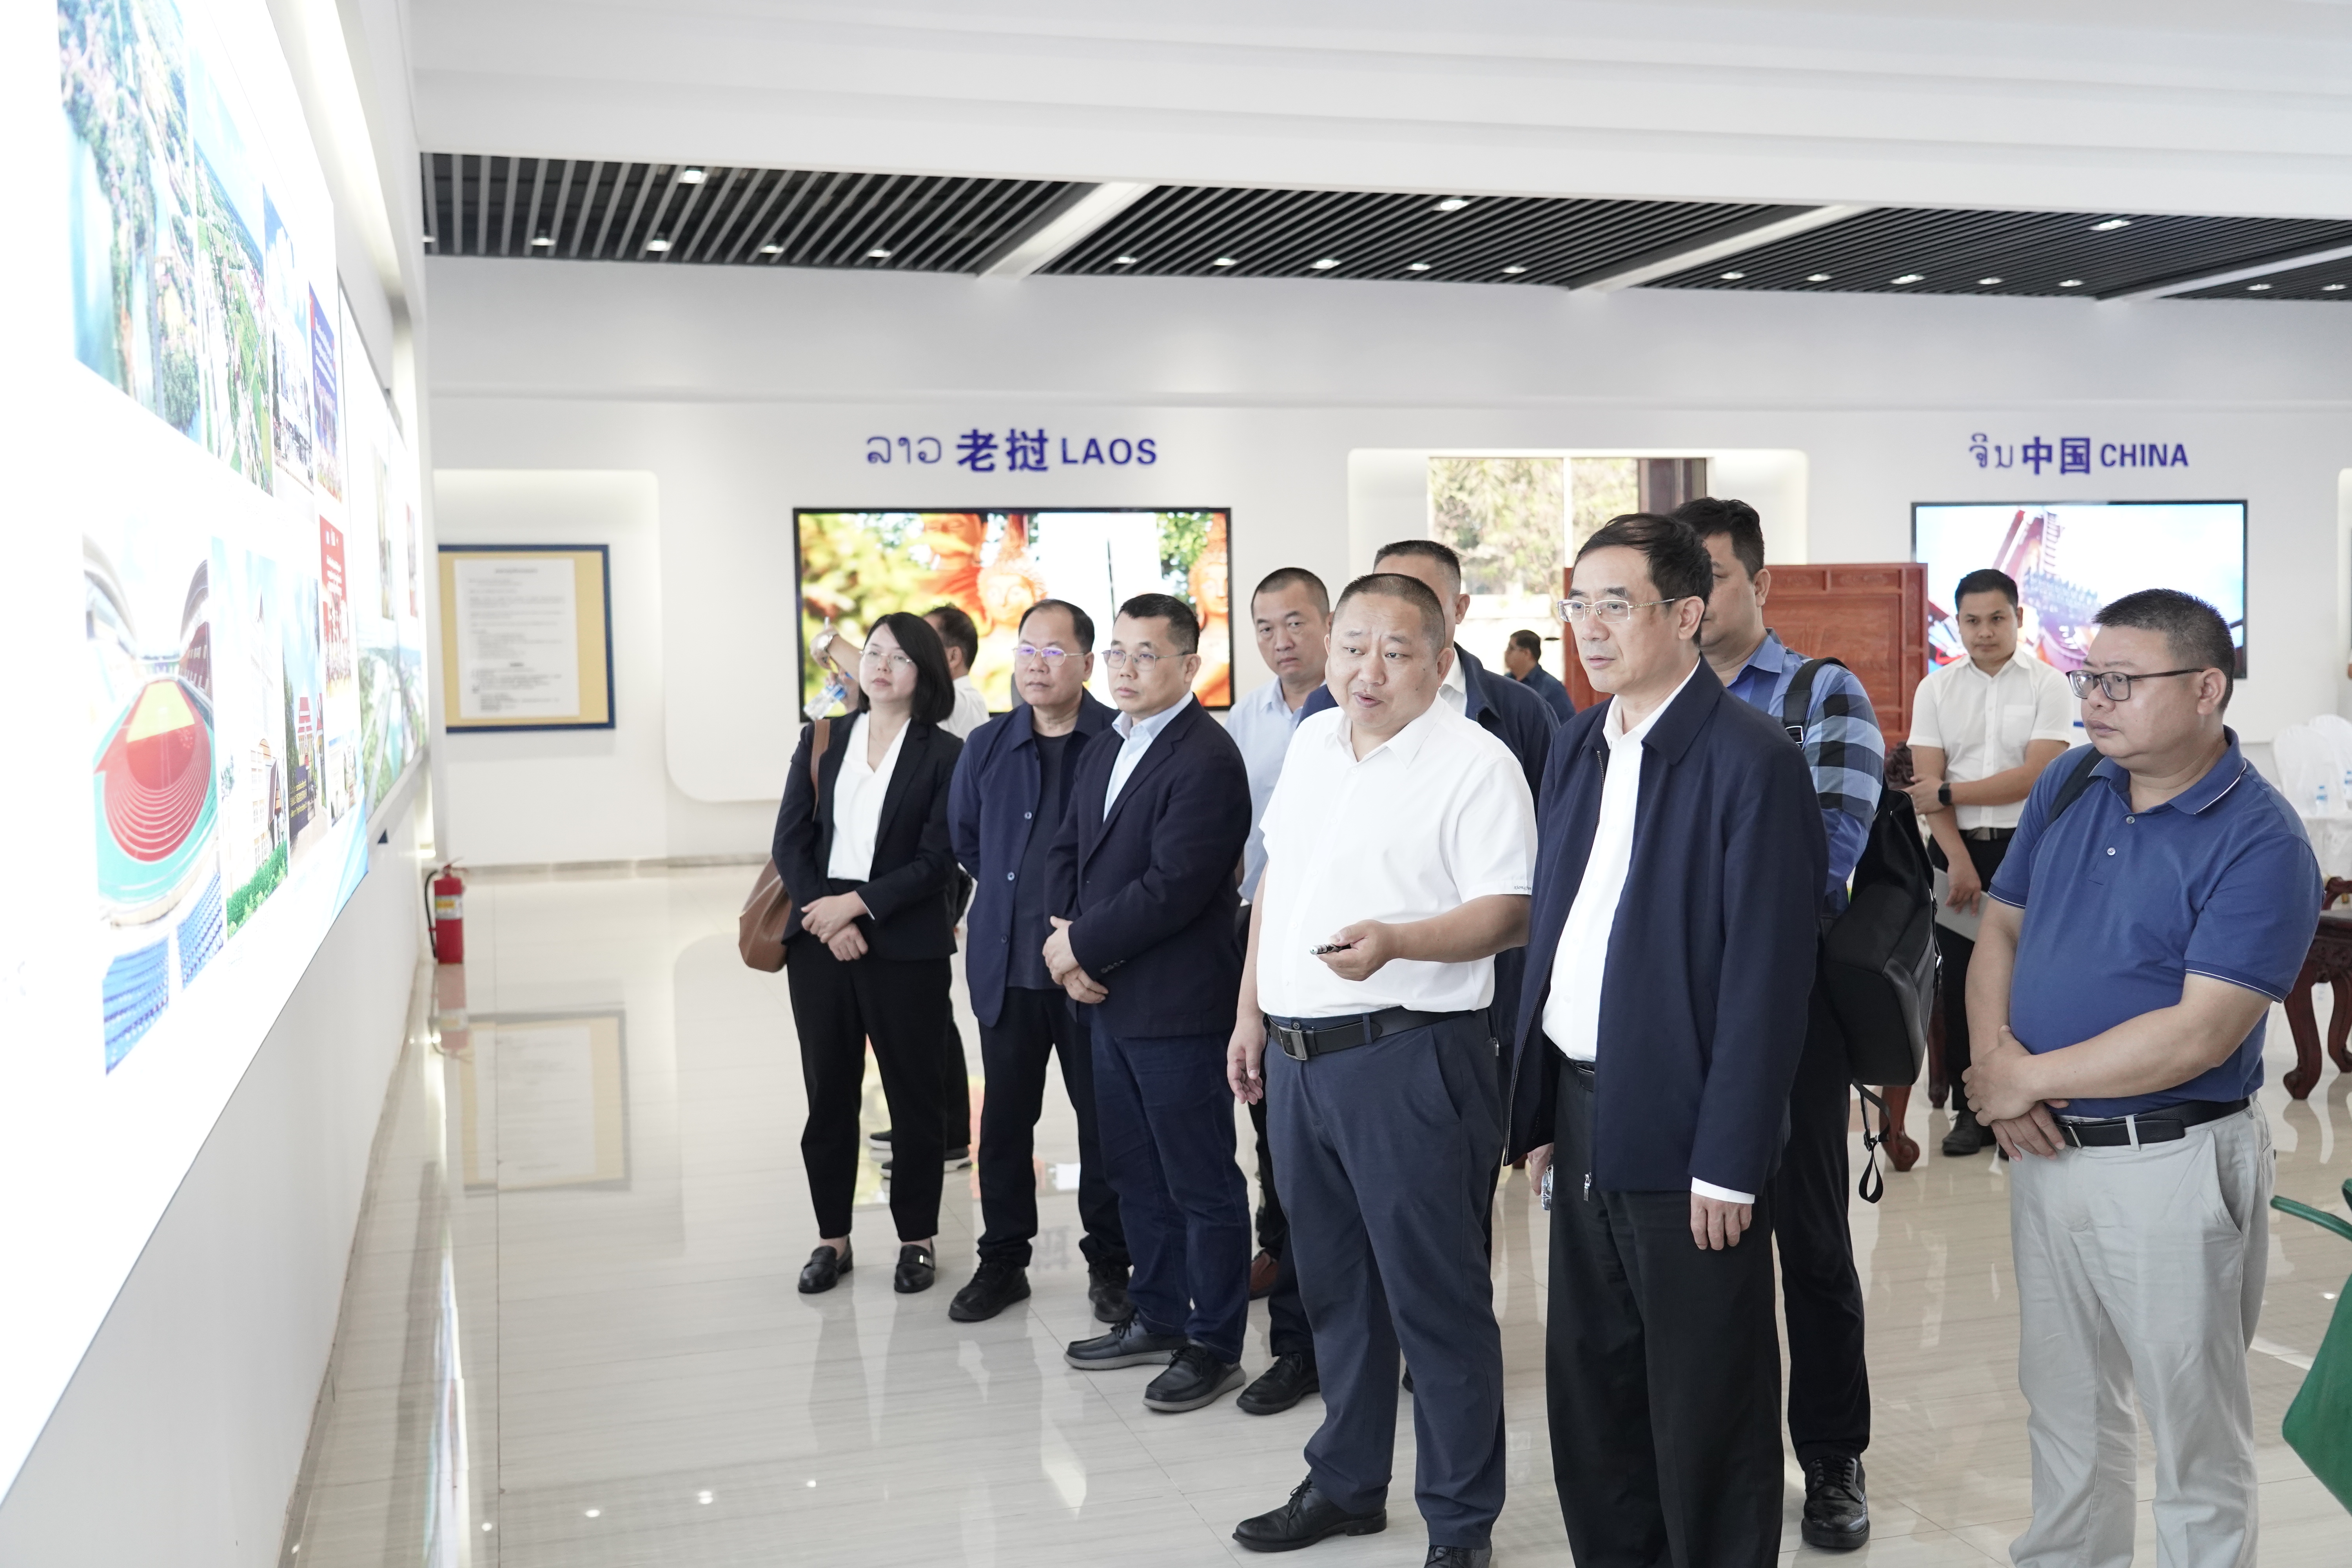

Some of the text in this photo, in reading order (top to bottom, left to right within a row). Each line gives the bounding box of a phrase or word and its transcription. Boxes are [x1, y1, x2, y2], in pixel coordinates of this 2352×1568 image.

[866, 428, 1157, 473] ລາວ 老挝 LAOS
[2022, 436, 2092, 476] 中国
[2100, 443, 2189, 468] CHINA
